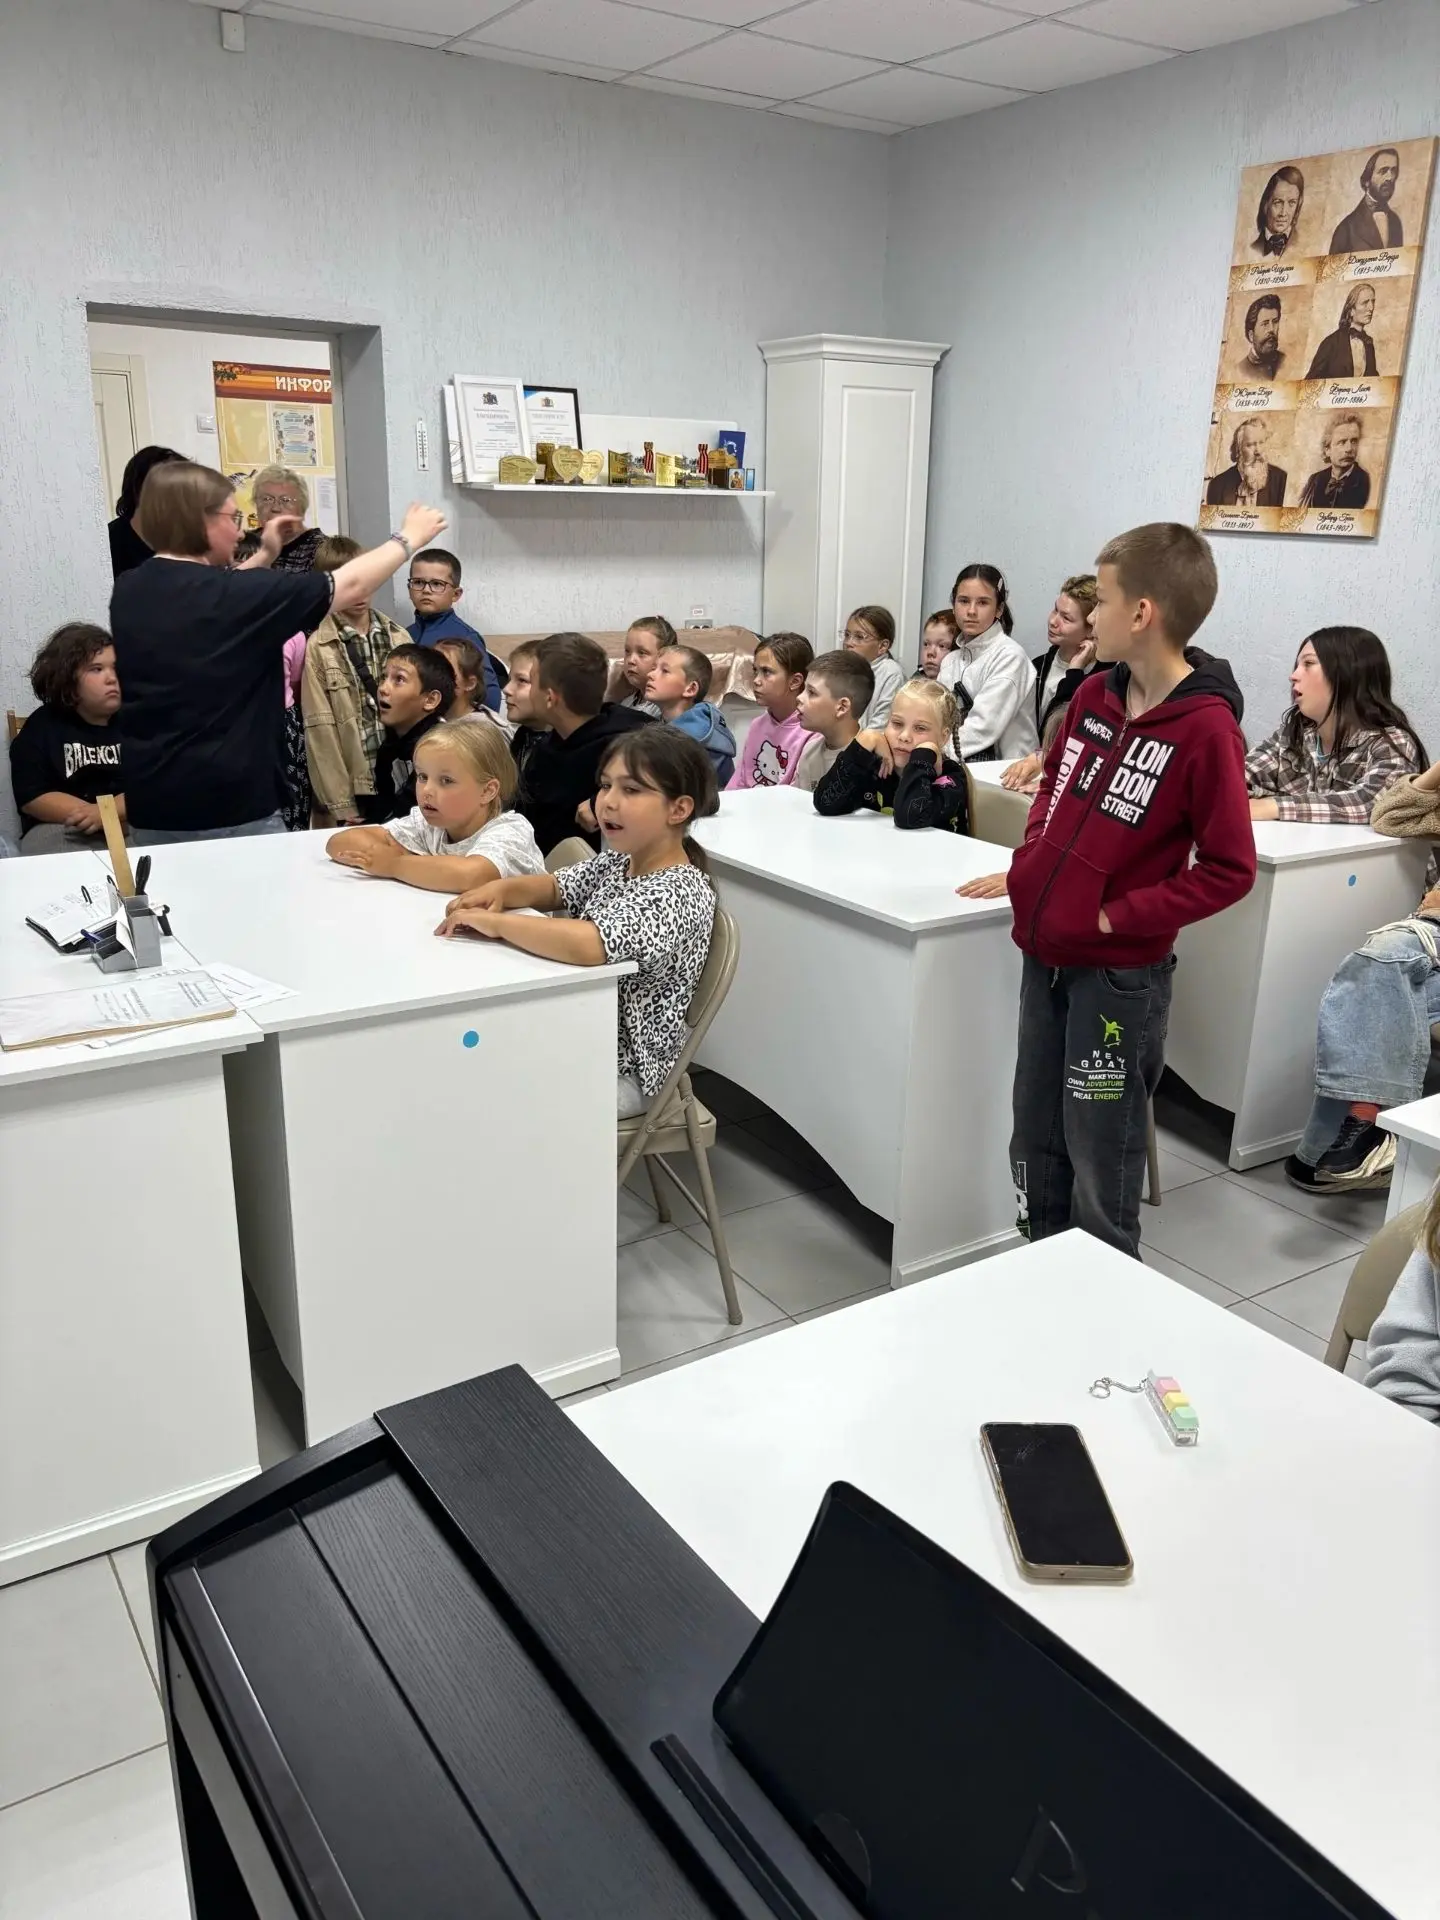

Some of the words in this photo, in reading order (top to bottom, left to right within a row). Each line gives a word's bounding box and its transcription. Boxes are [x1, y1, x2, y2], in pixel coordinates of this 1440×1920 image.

[1122, 736, 1174, 776] LON
[1108, 766, 1157, 807] DON
[1101, 794, 1145, 824] STREET
[1081, 1060, 1127, 1071] GOAL
[1067, 1077, 1085, 1087] OWN
[1072, 1091, 1093, 1100] REAL
[1093, 1092, 1124, 1100] ENERGY
